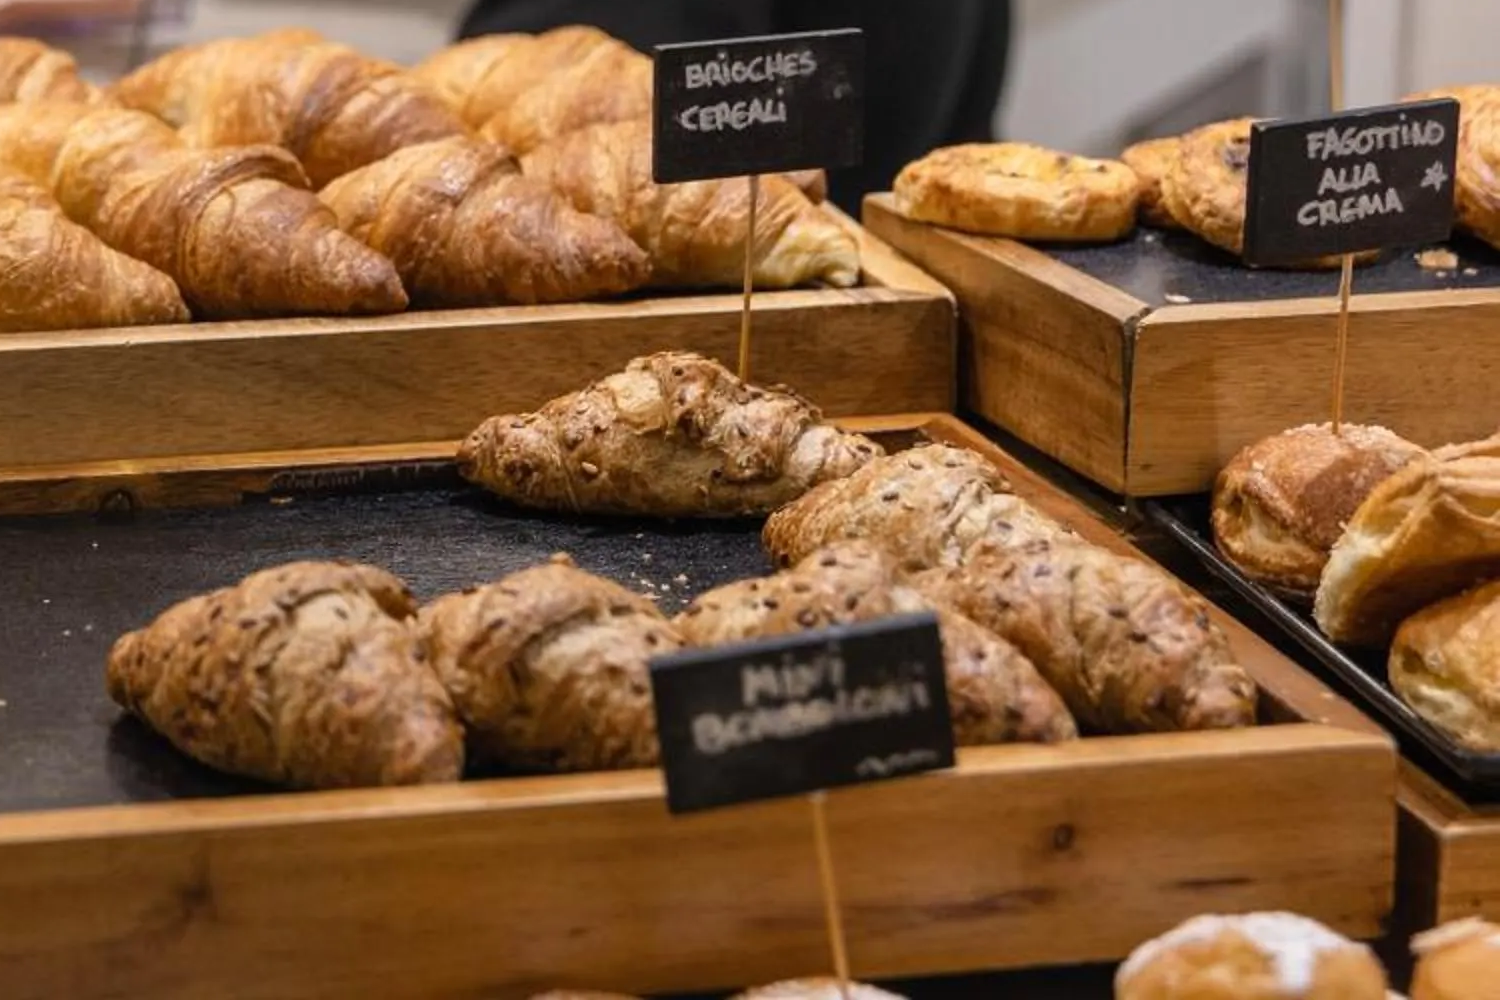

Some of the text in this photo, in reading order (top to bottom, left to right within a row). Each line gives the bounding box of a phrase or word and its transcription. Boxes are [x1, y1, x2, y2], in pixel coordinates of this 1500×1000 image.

[685, 50, 817, 89] BRIOCHES
[679, 87, 787, 131] CEREALI
[1306, 113, 1445, 160] FAGOTTINO
[1317, 161, 1381, 195] ALLA
[1297, 187, 1404, 226] CREMA
